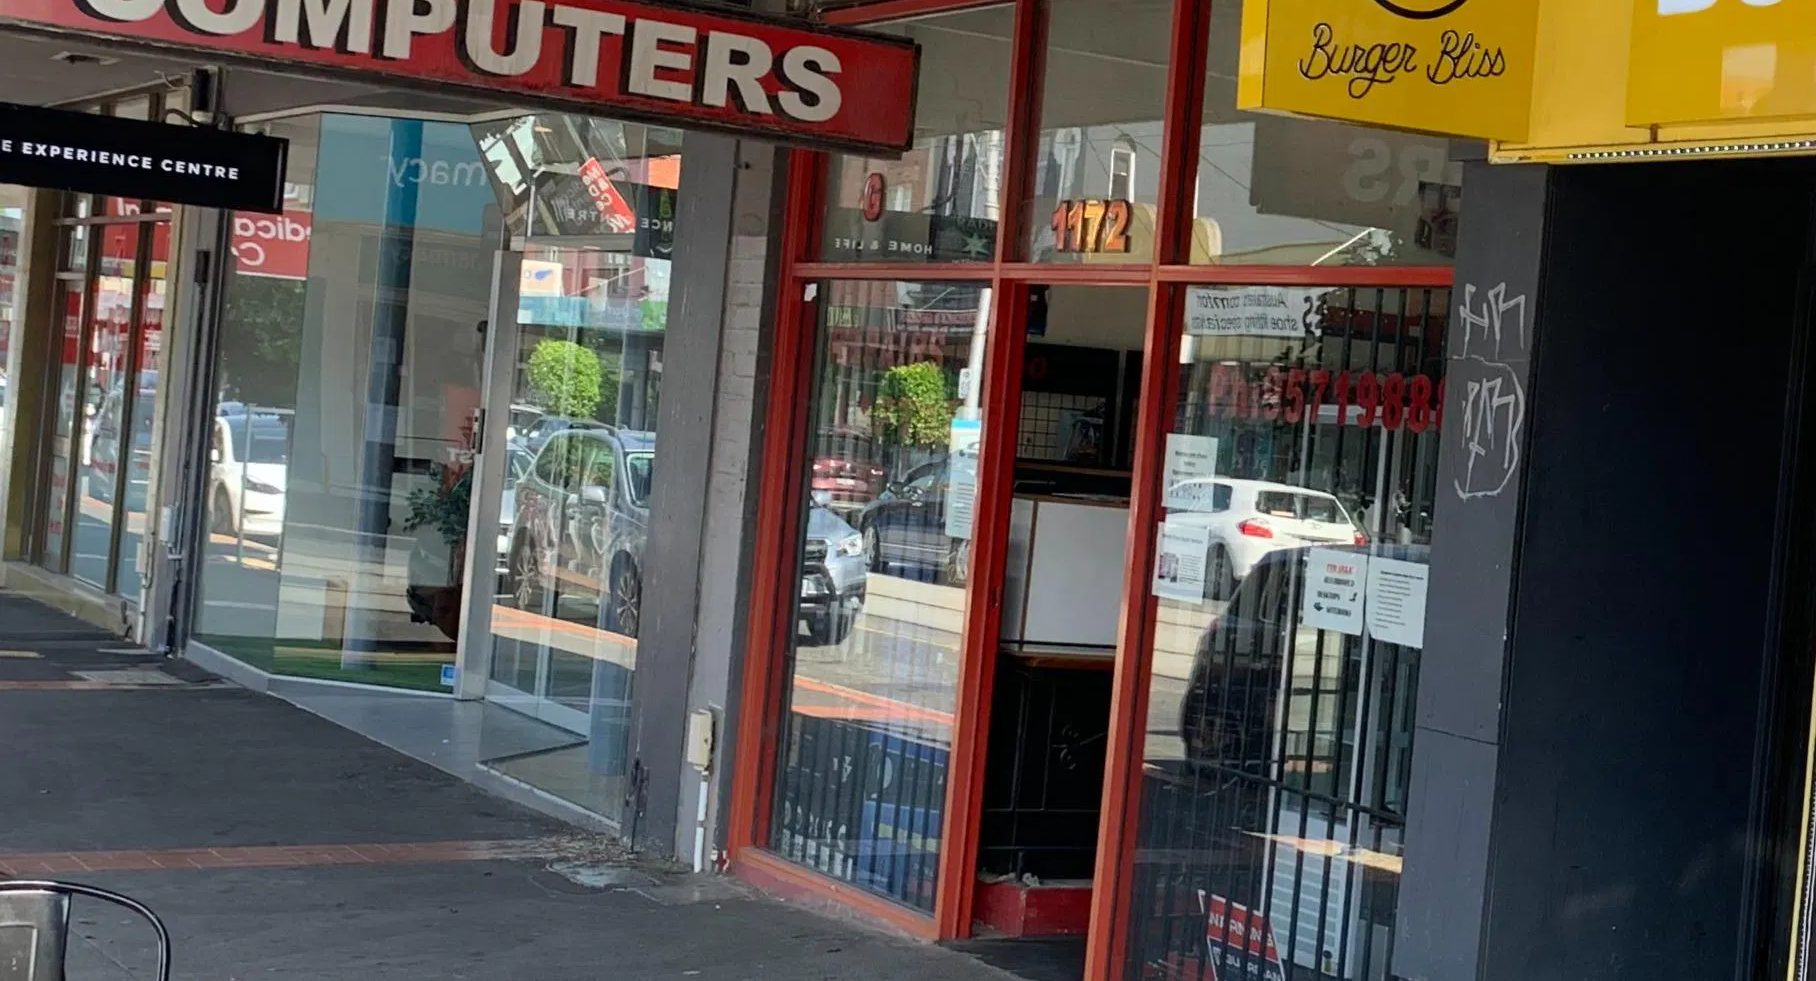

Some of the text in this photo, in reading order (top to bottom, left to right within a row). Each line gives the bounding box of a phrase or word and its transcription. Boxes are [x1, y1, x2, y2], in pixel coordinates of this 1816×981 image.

[1299, 22, 1506, 100] Burger Bliss
[22, 141, 153, 170] EXPERIENCE
[161, 158, 240, 180] CENTRE
[1052, 199, 1134, 253] 1172
